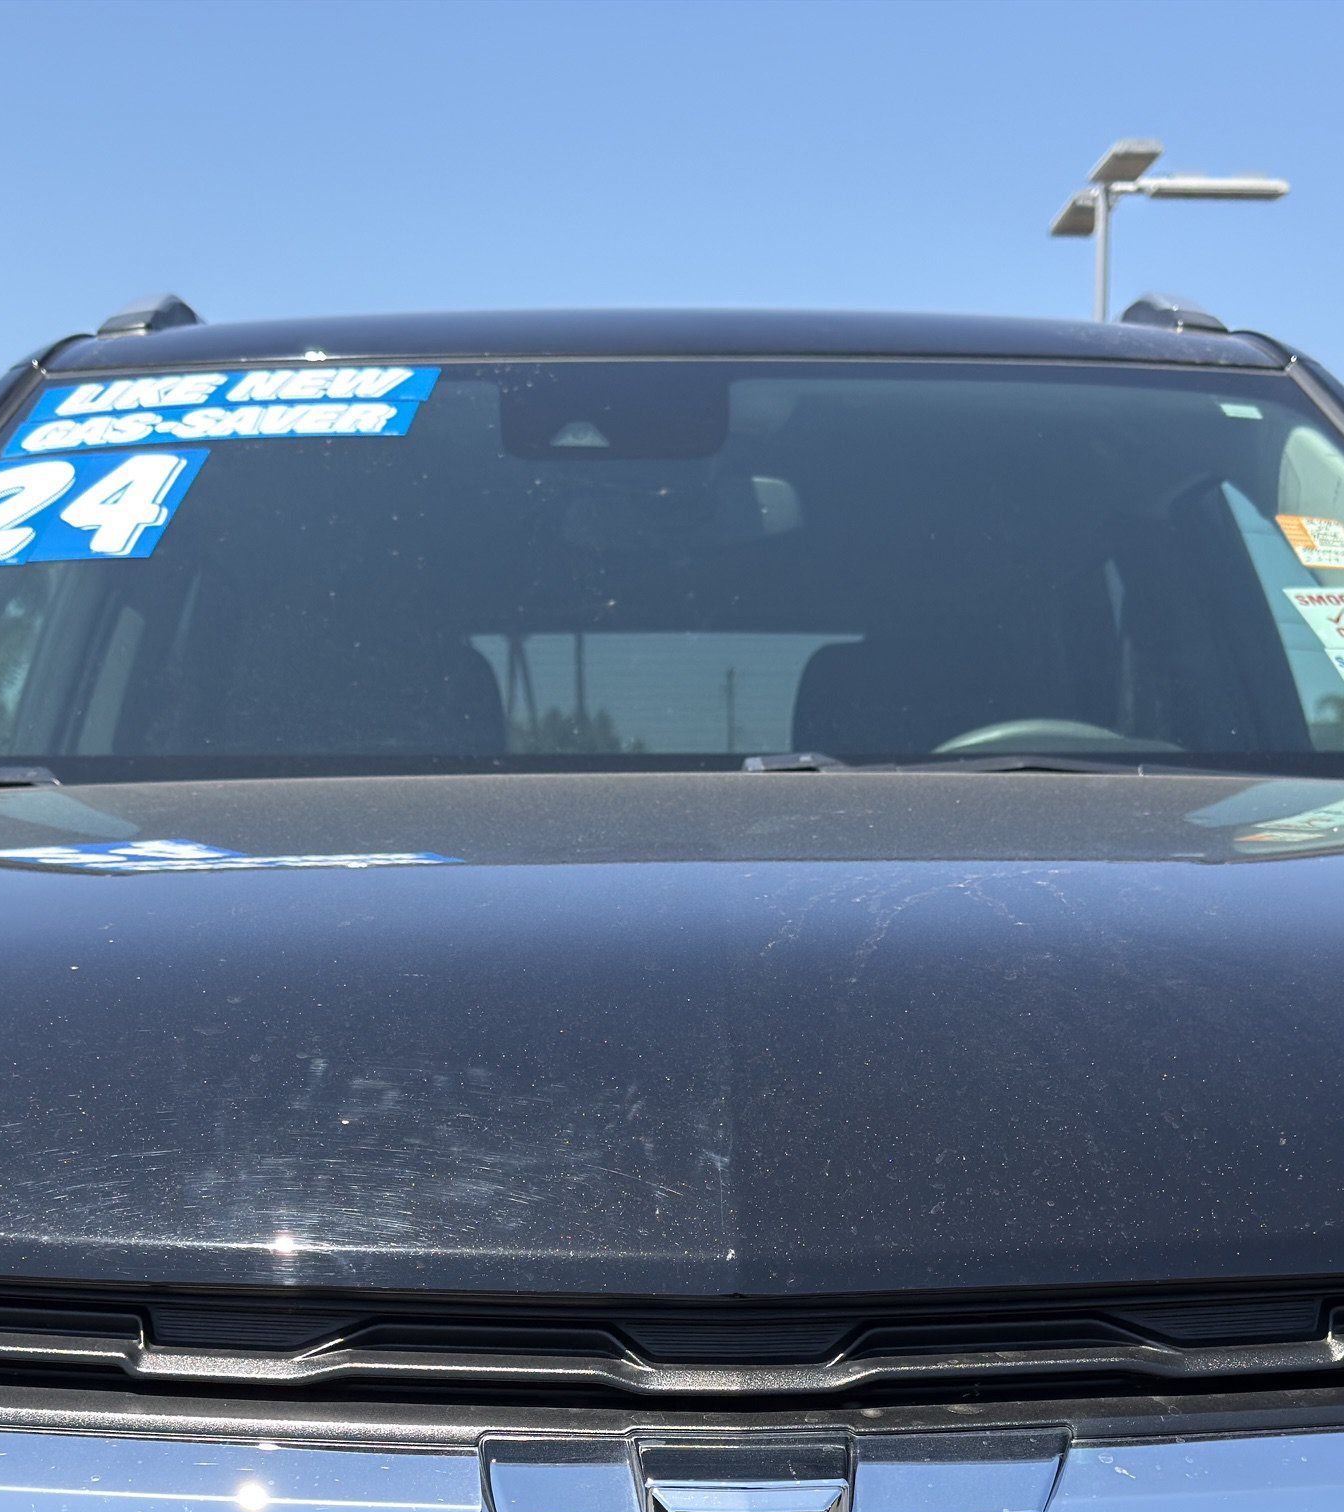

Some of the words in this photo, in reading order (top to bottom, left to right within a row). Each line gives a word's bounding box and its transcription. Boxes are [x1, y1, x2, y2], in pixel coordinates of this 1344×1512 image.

[55, 373, 227, 416] LIKE
[227, 367, 414, 402] NEW
[21, 402, 397, 452] GAS-SAVER
